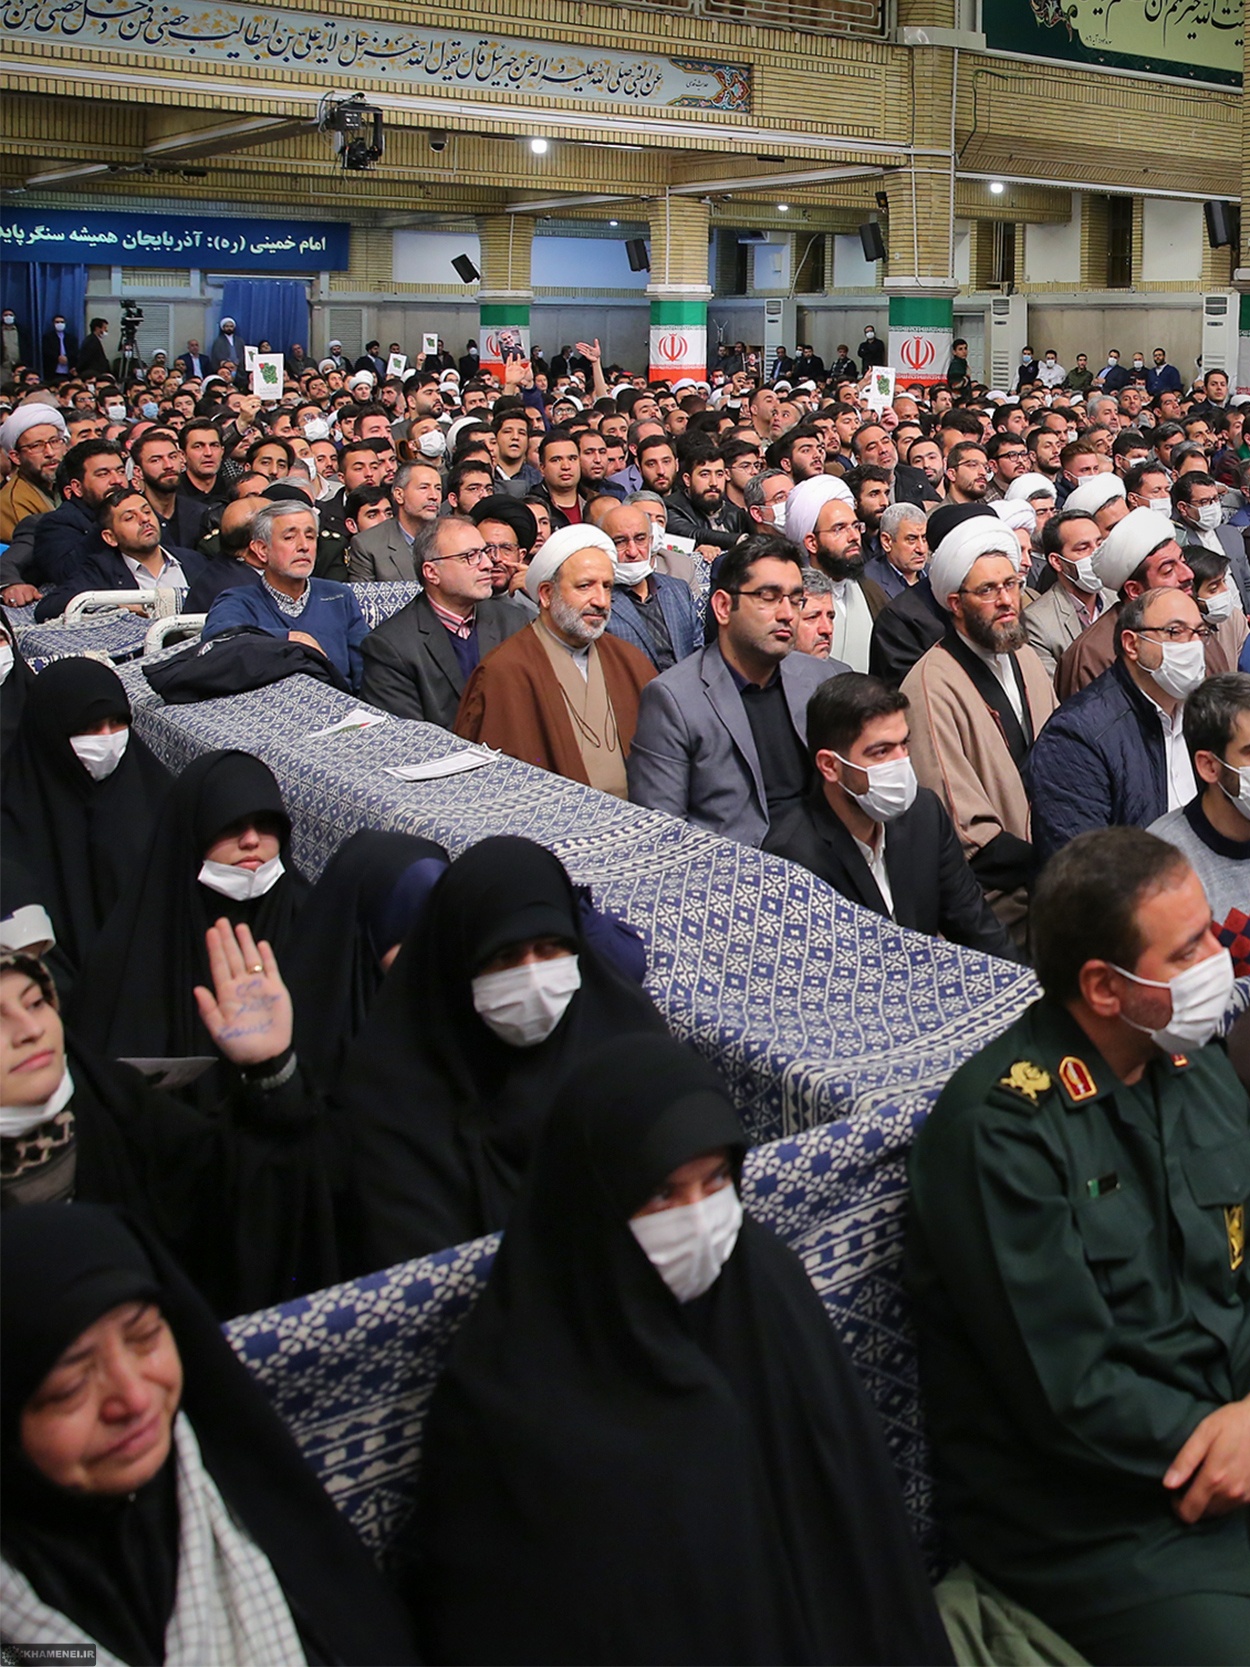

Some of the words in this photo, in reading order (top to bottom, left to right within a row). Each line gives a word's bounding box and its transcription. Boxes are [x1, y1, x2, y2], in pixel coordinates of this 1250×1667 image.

[456, 40, 489, 79] قال
[640, 72, 663, 97] عن
[25, 224, 65, 245] سنگر
[69, 226, 119, 247] همیشه
[122, 229, 204, 251] آذربایجان
[250, 235, 296, 254] خمینی
[299, 236, 326, 254] امام
